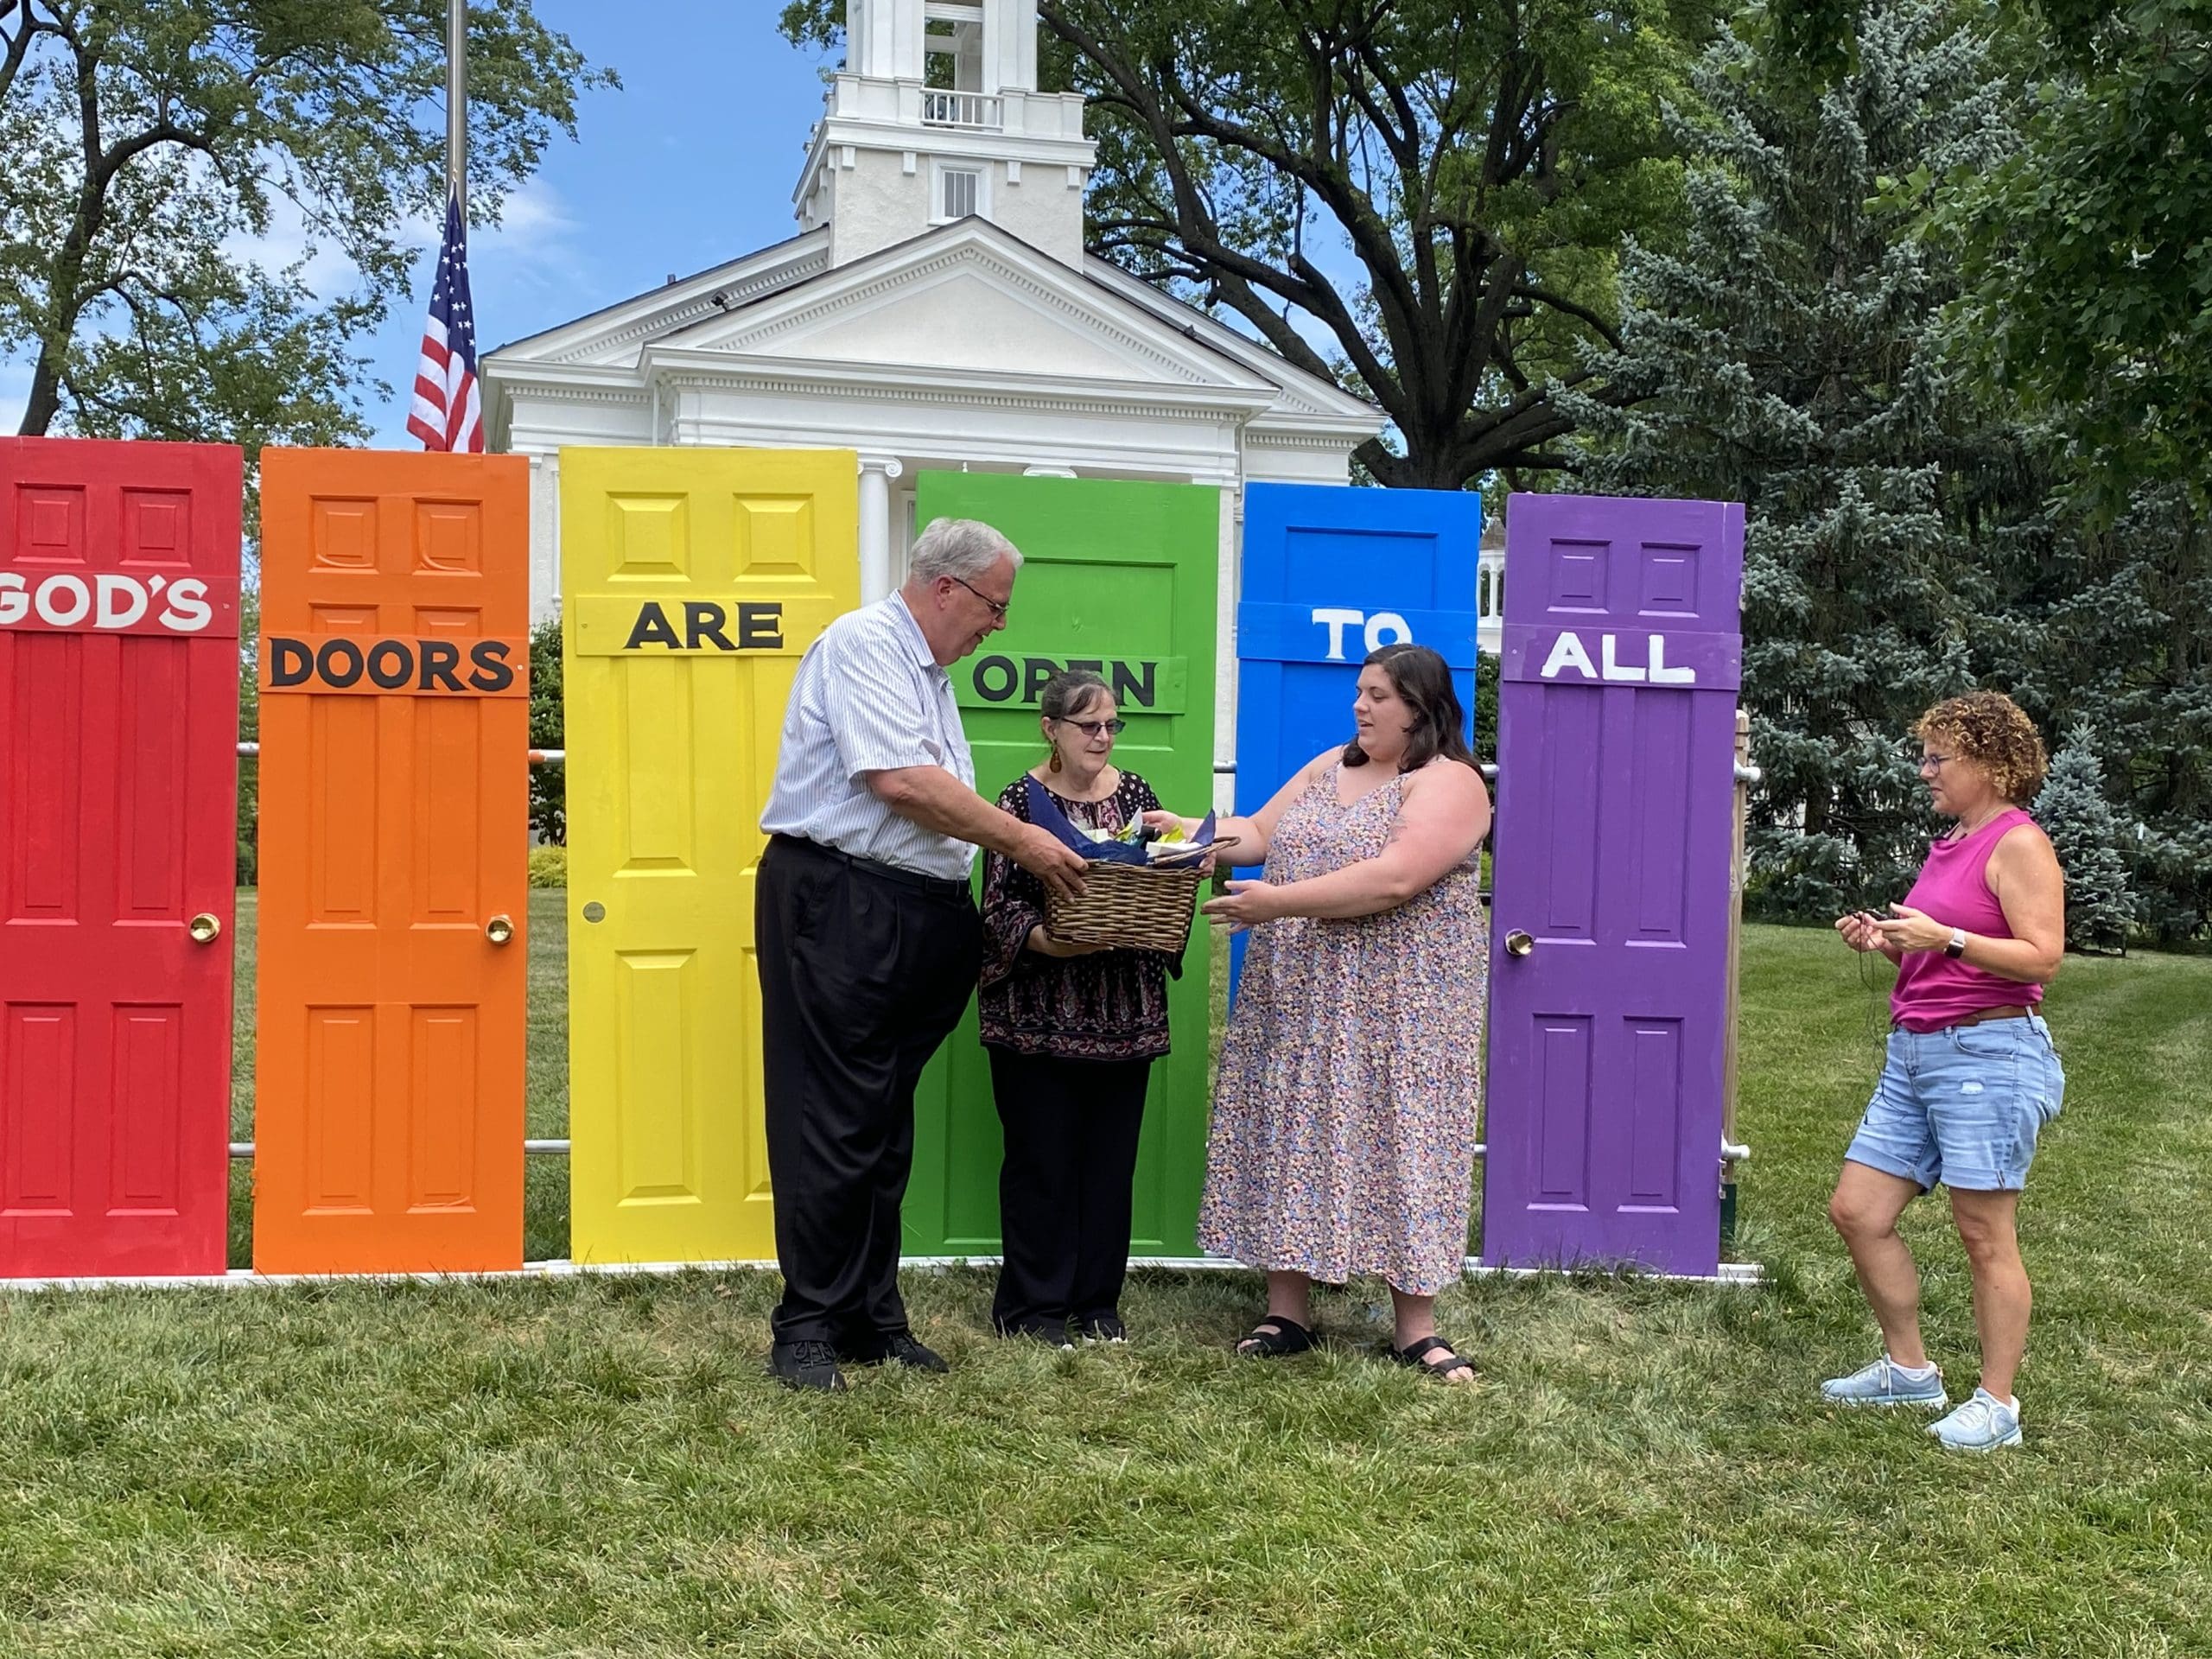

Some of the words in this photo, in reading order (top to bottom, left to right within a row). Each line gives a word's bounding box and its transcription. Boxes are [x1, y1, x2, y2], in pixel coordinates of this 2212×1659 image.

[0, 572, 213, 632] GOD'S
[622, 601, 784, 650] ARE
[1312, 608, 1413, 660] TO
[1541, 632, 1695, 683] ALL
[268, 637, 514, 691] DOORS
[973, 655, 1159, 707] OPN
